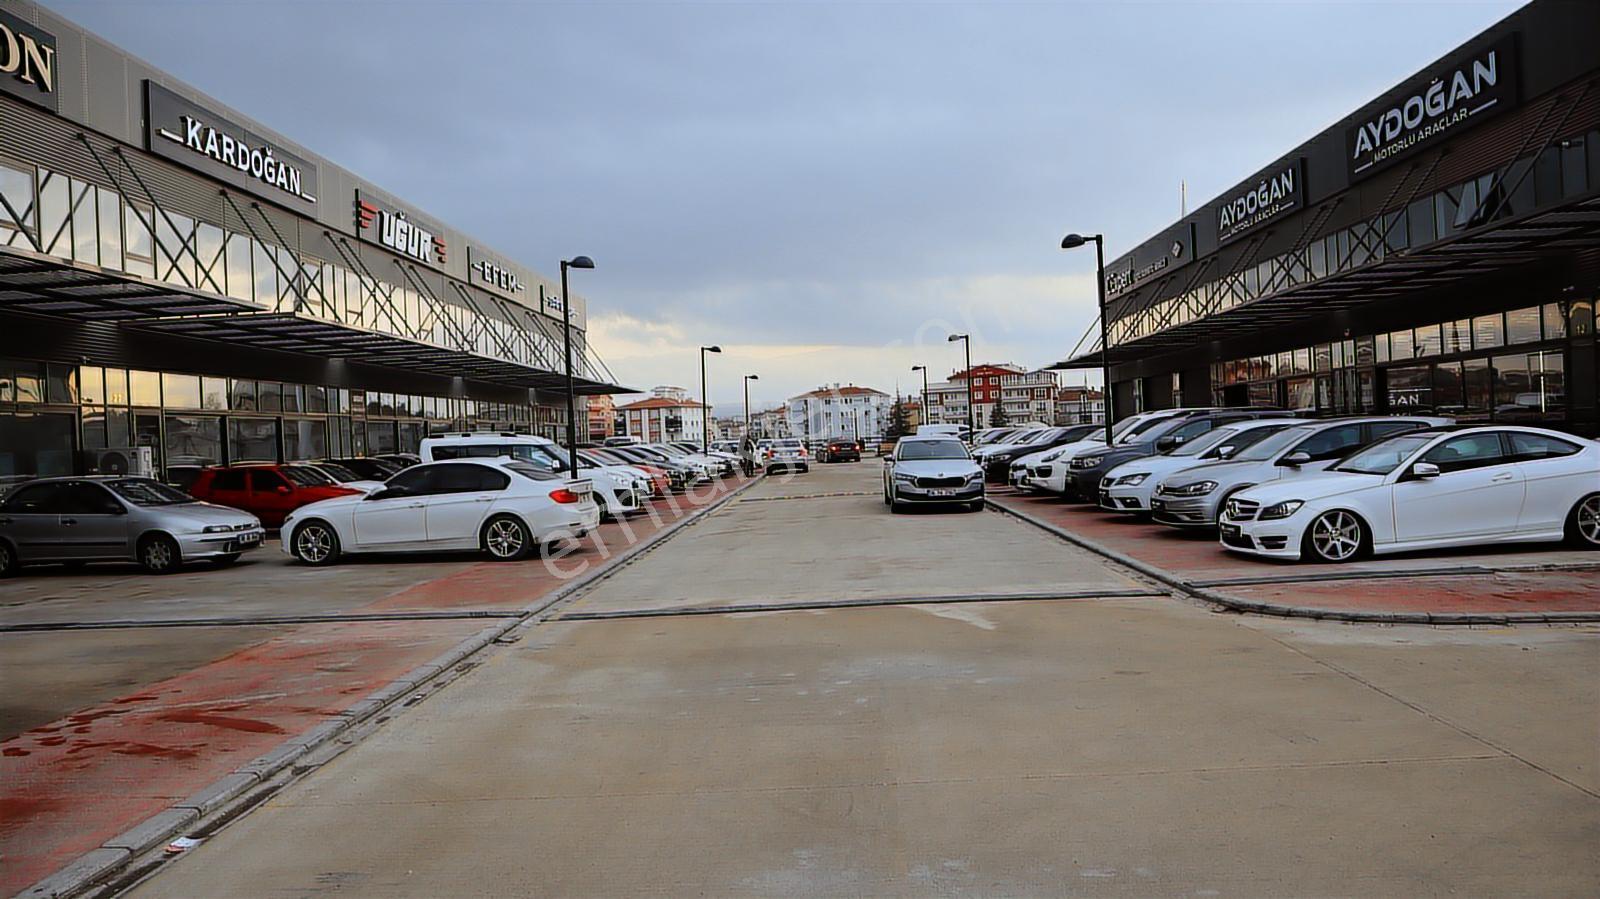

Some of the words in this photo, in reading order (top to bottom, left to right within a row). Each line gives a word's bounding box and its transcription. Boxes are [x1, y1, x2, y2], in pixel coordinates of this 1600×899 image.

[1353, 50, 1497, 160] AYDOĞAN
[1373, 132, 1416, 164] MOTORLU
[1417, 107, 1468, 143] ARAÇLAR
[186, 115, 301, 196] KARDOĞAN
[1220, 168, 1293, 230] AYDOĞAN
[382, 208, 432, 263] UĞUR
